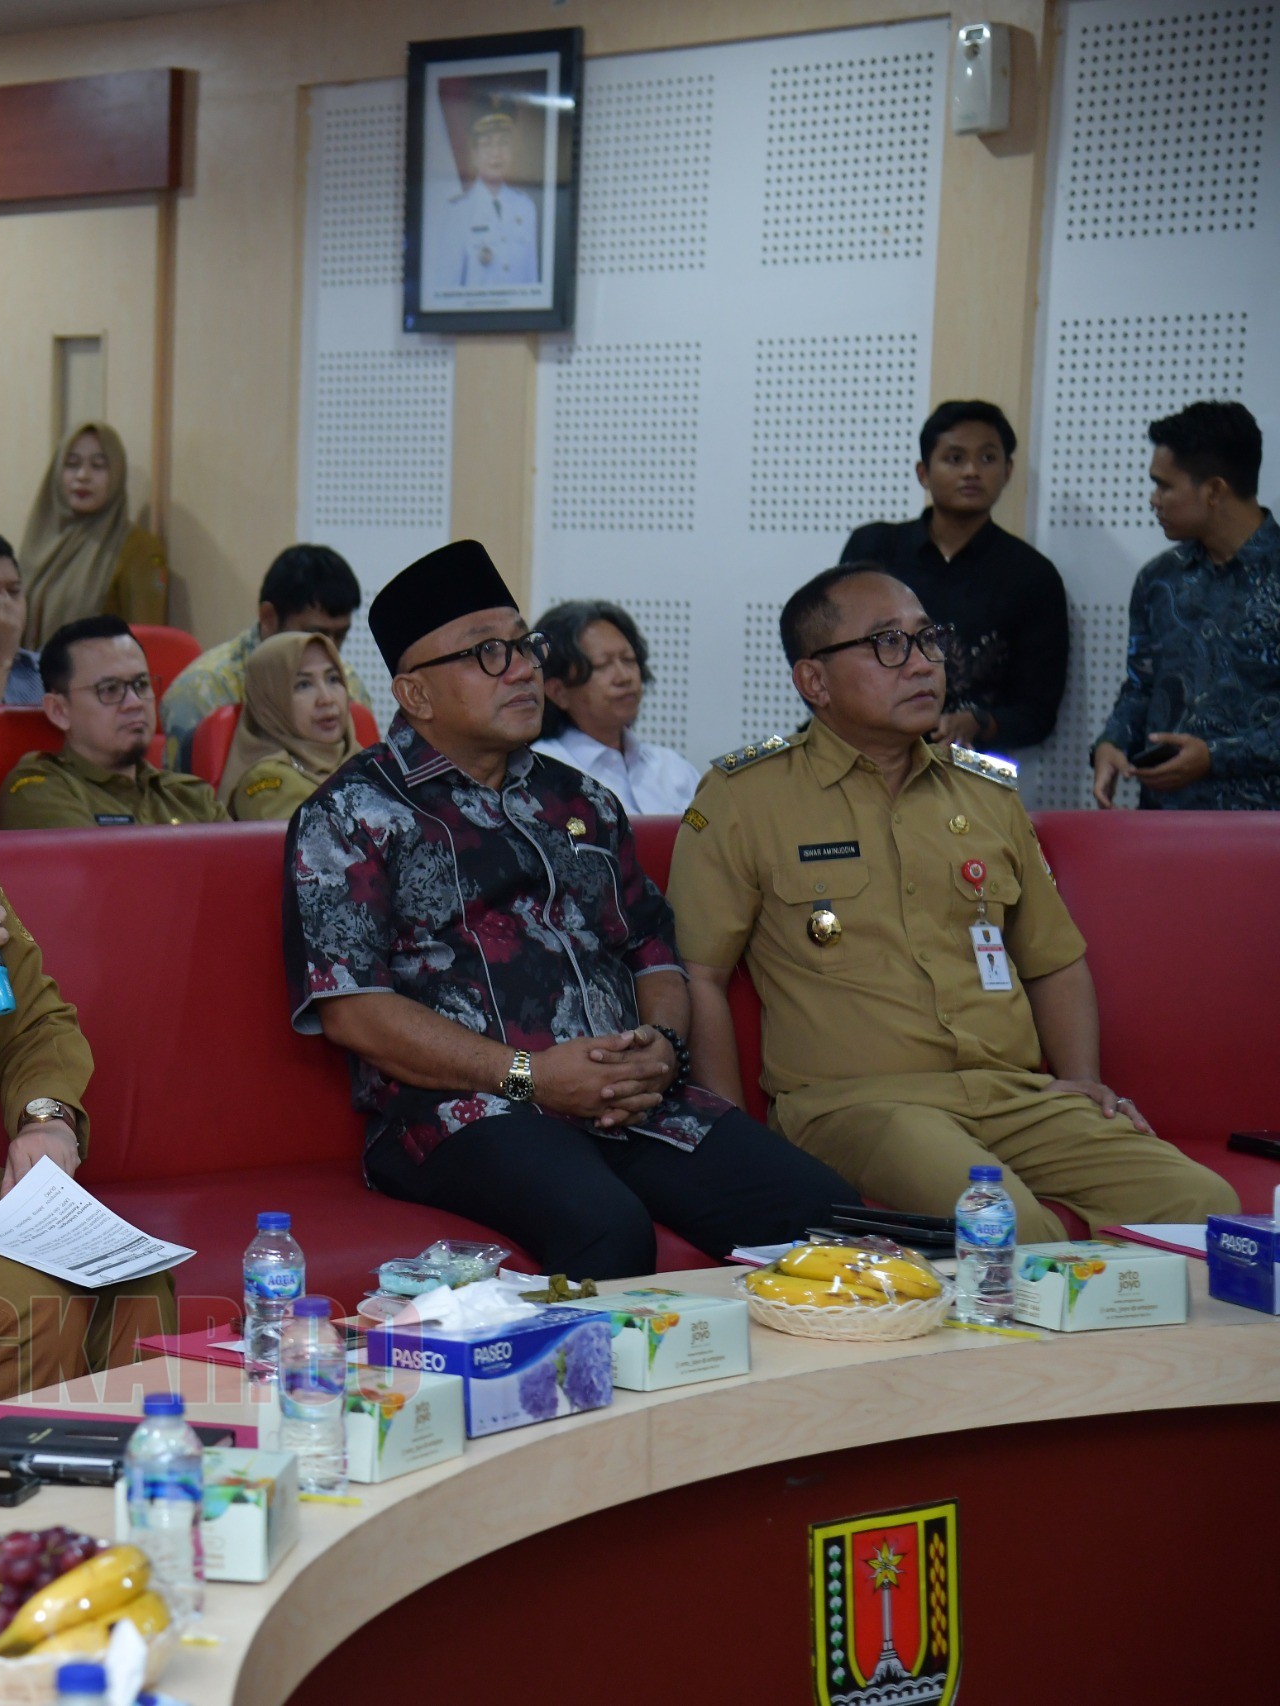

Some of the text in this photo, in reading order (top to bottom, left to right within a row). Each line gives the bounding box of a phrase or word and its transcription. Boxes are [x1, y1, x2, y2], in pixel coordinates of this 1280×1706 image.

[1221, 1232, 1258, 1256] PASEO
[267, 1275, 296, 1287] AQUA
[1118, 1269, 1139, 1280] arto
[1117, 1280, 1141, 1293] joyo
[392, 1348, 446, 1372] PASEO
[473, 1341, 513, 1367] PASEO
